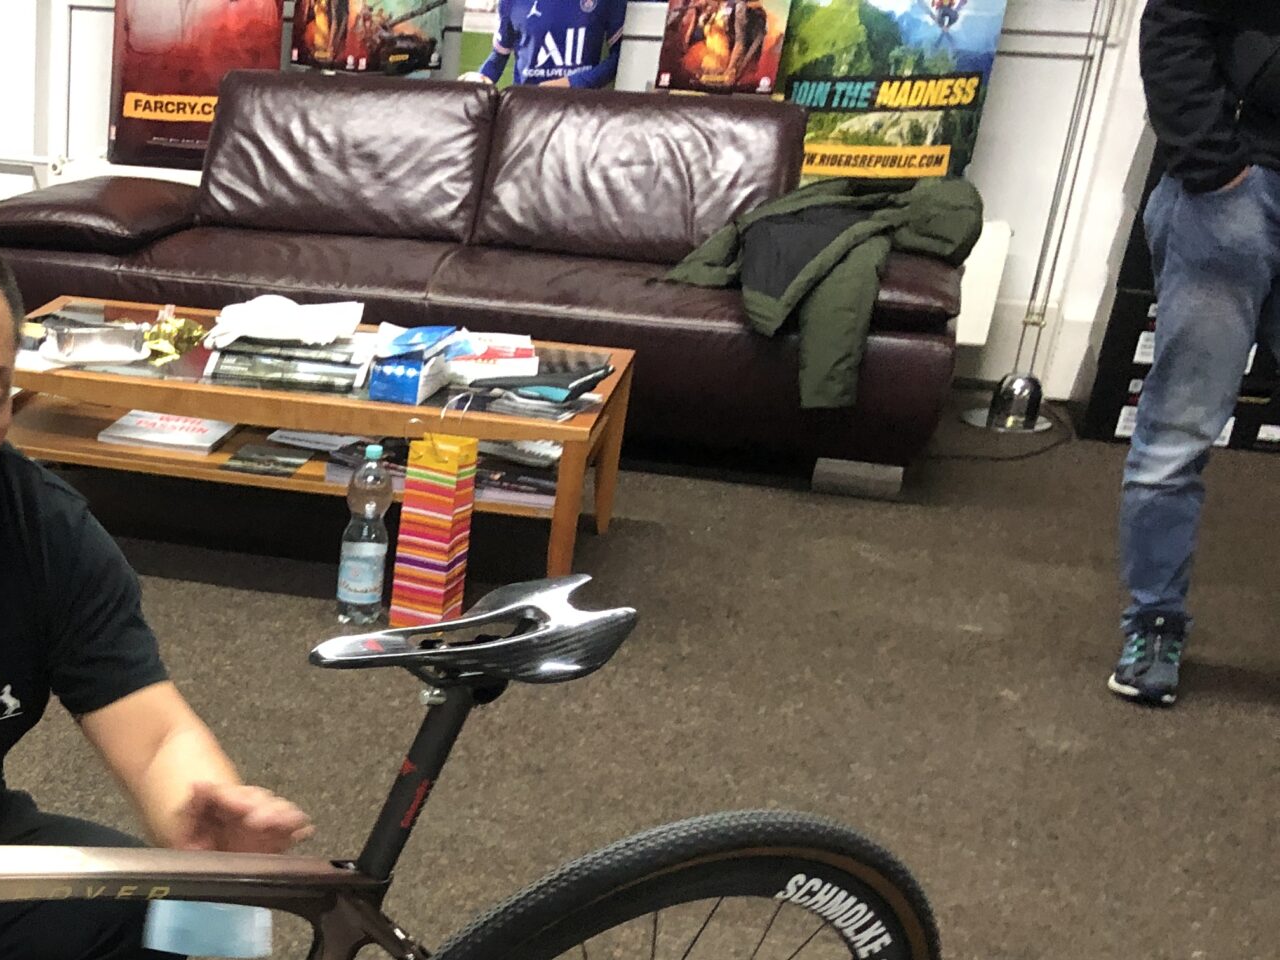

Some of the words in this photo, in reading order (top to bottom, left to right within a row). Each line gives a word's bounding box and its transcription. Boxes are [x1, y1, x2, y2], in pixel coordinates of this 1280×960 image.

[832, 81, 877, 108] THE
[874, 77, 979, 108] MADNESS
[774, 873, 893, 959] SCHMOLKE
